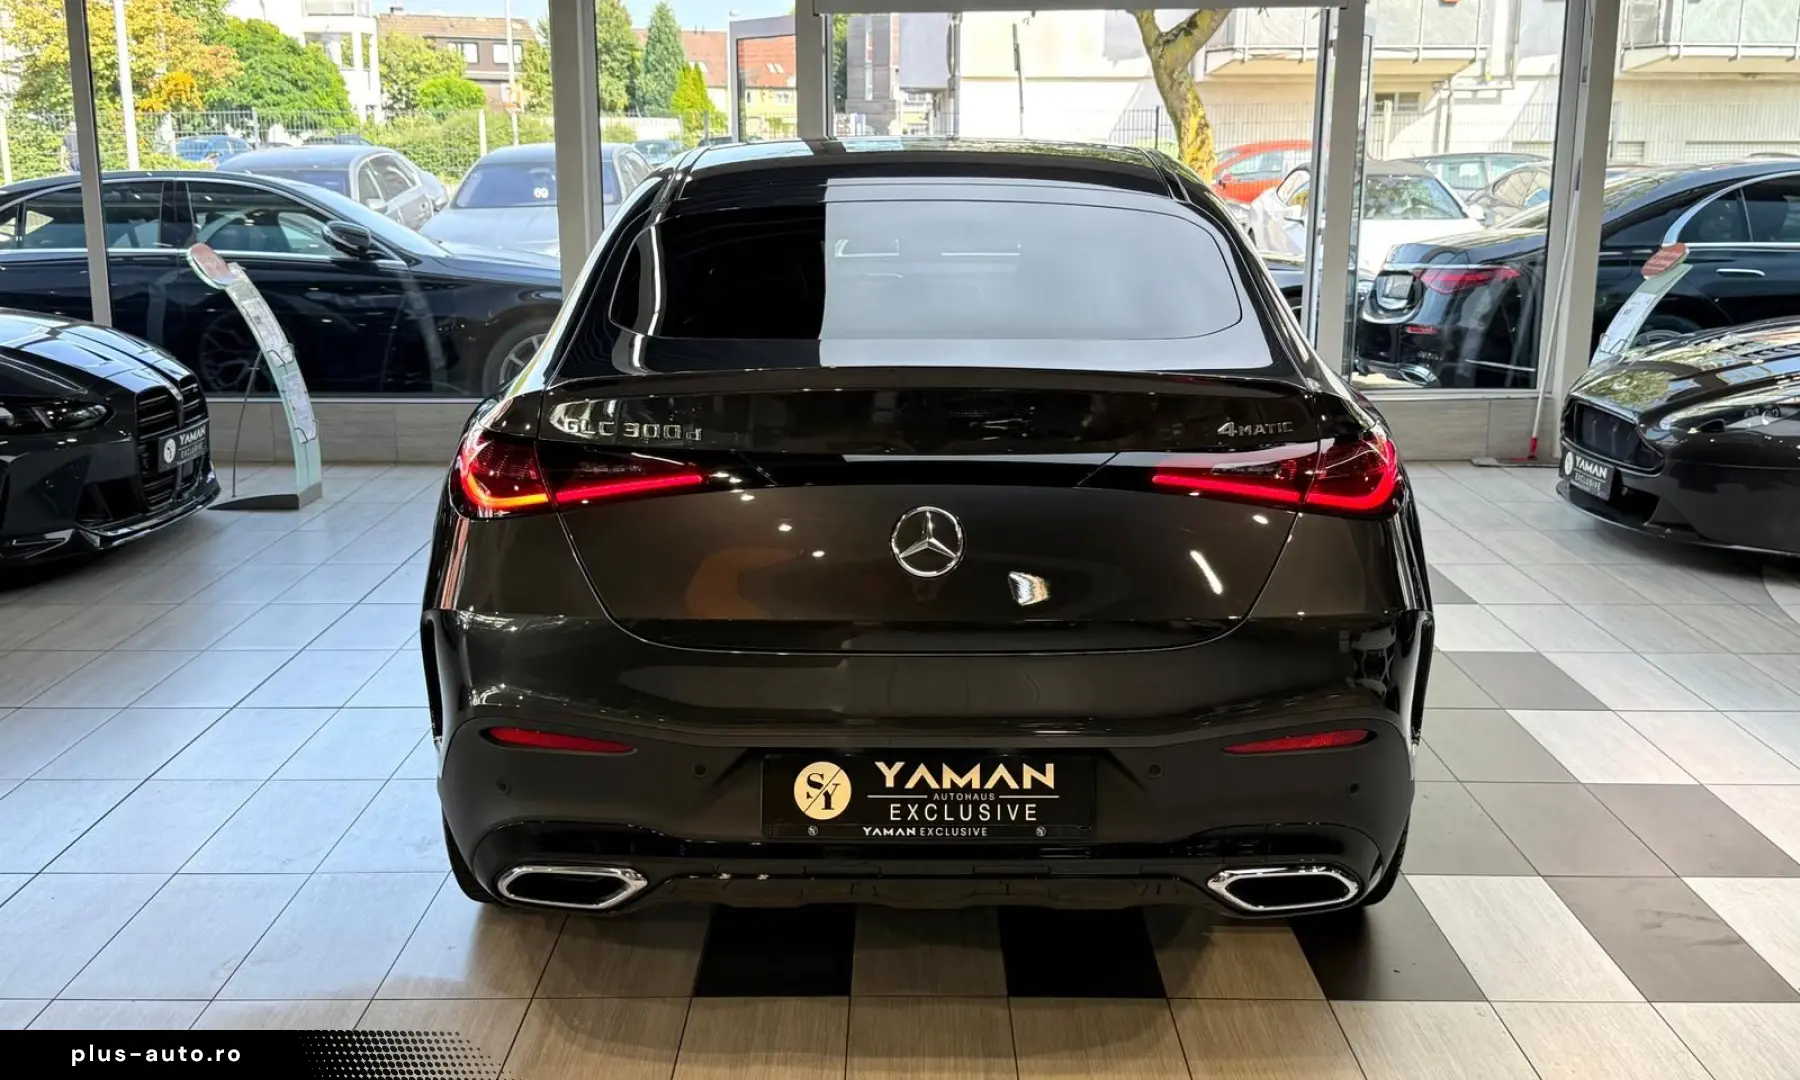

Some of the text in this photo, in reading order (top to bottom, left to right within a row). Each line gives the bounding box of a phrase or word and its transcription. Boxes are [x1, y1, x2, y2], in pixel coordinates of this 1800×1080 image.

[564, 419, 615, 436] GLC
[1217, 421, 1294, 437] 4MATIC
[1575, 456, 1608, 479] YAMAN
[875, 761, 1054, 789] YAMAN
[933, 793, 995, 801] AUTOHAUS
[890, 803, 1037, 821] EXCLUSIVE
[863, 827, 987, 836] YAMAN EXCLUSIVE
